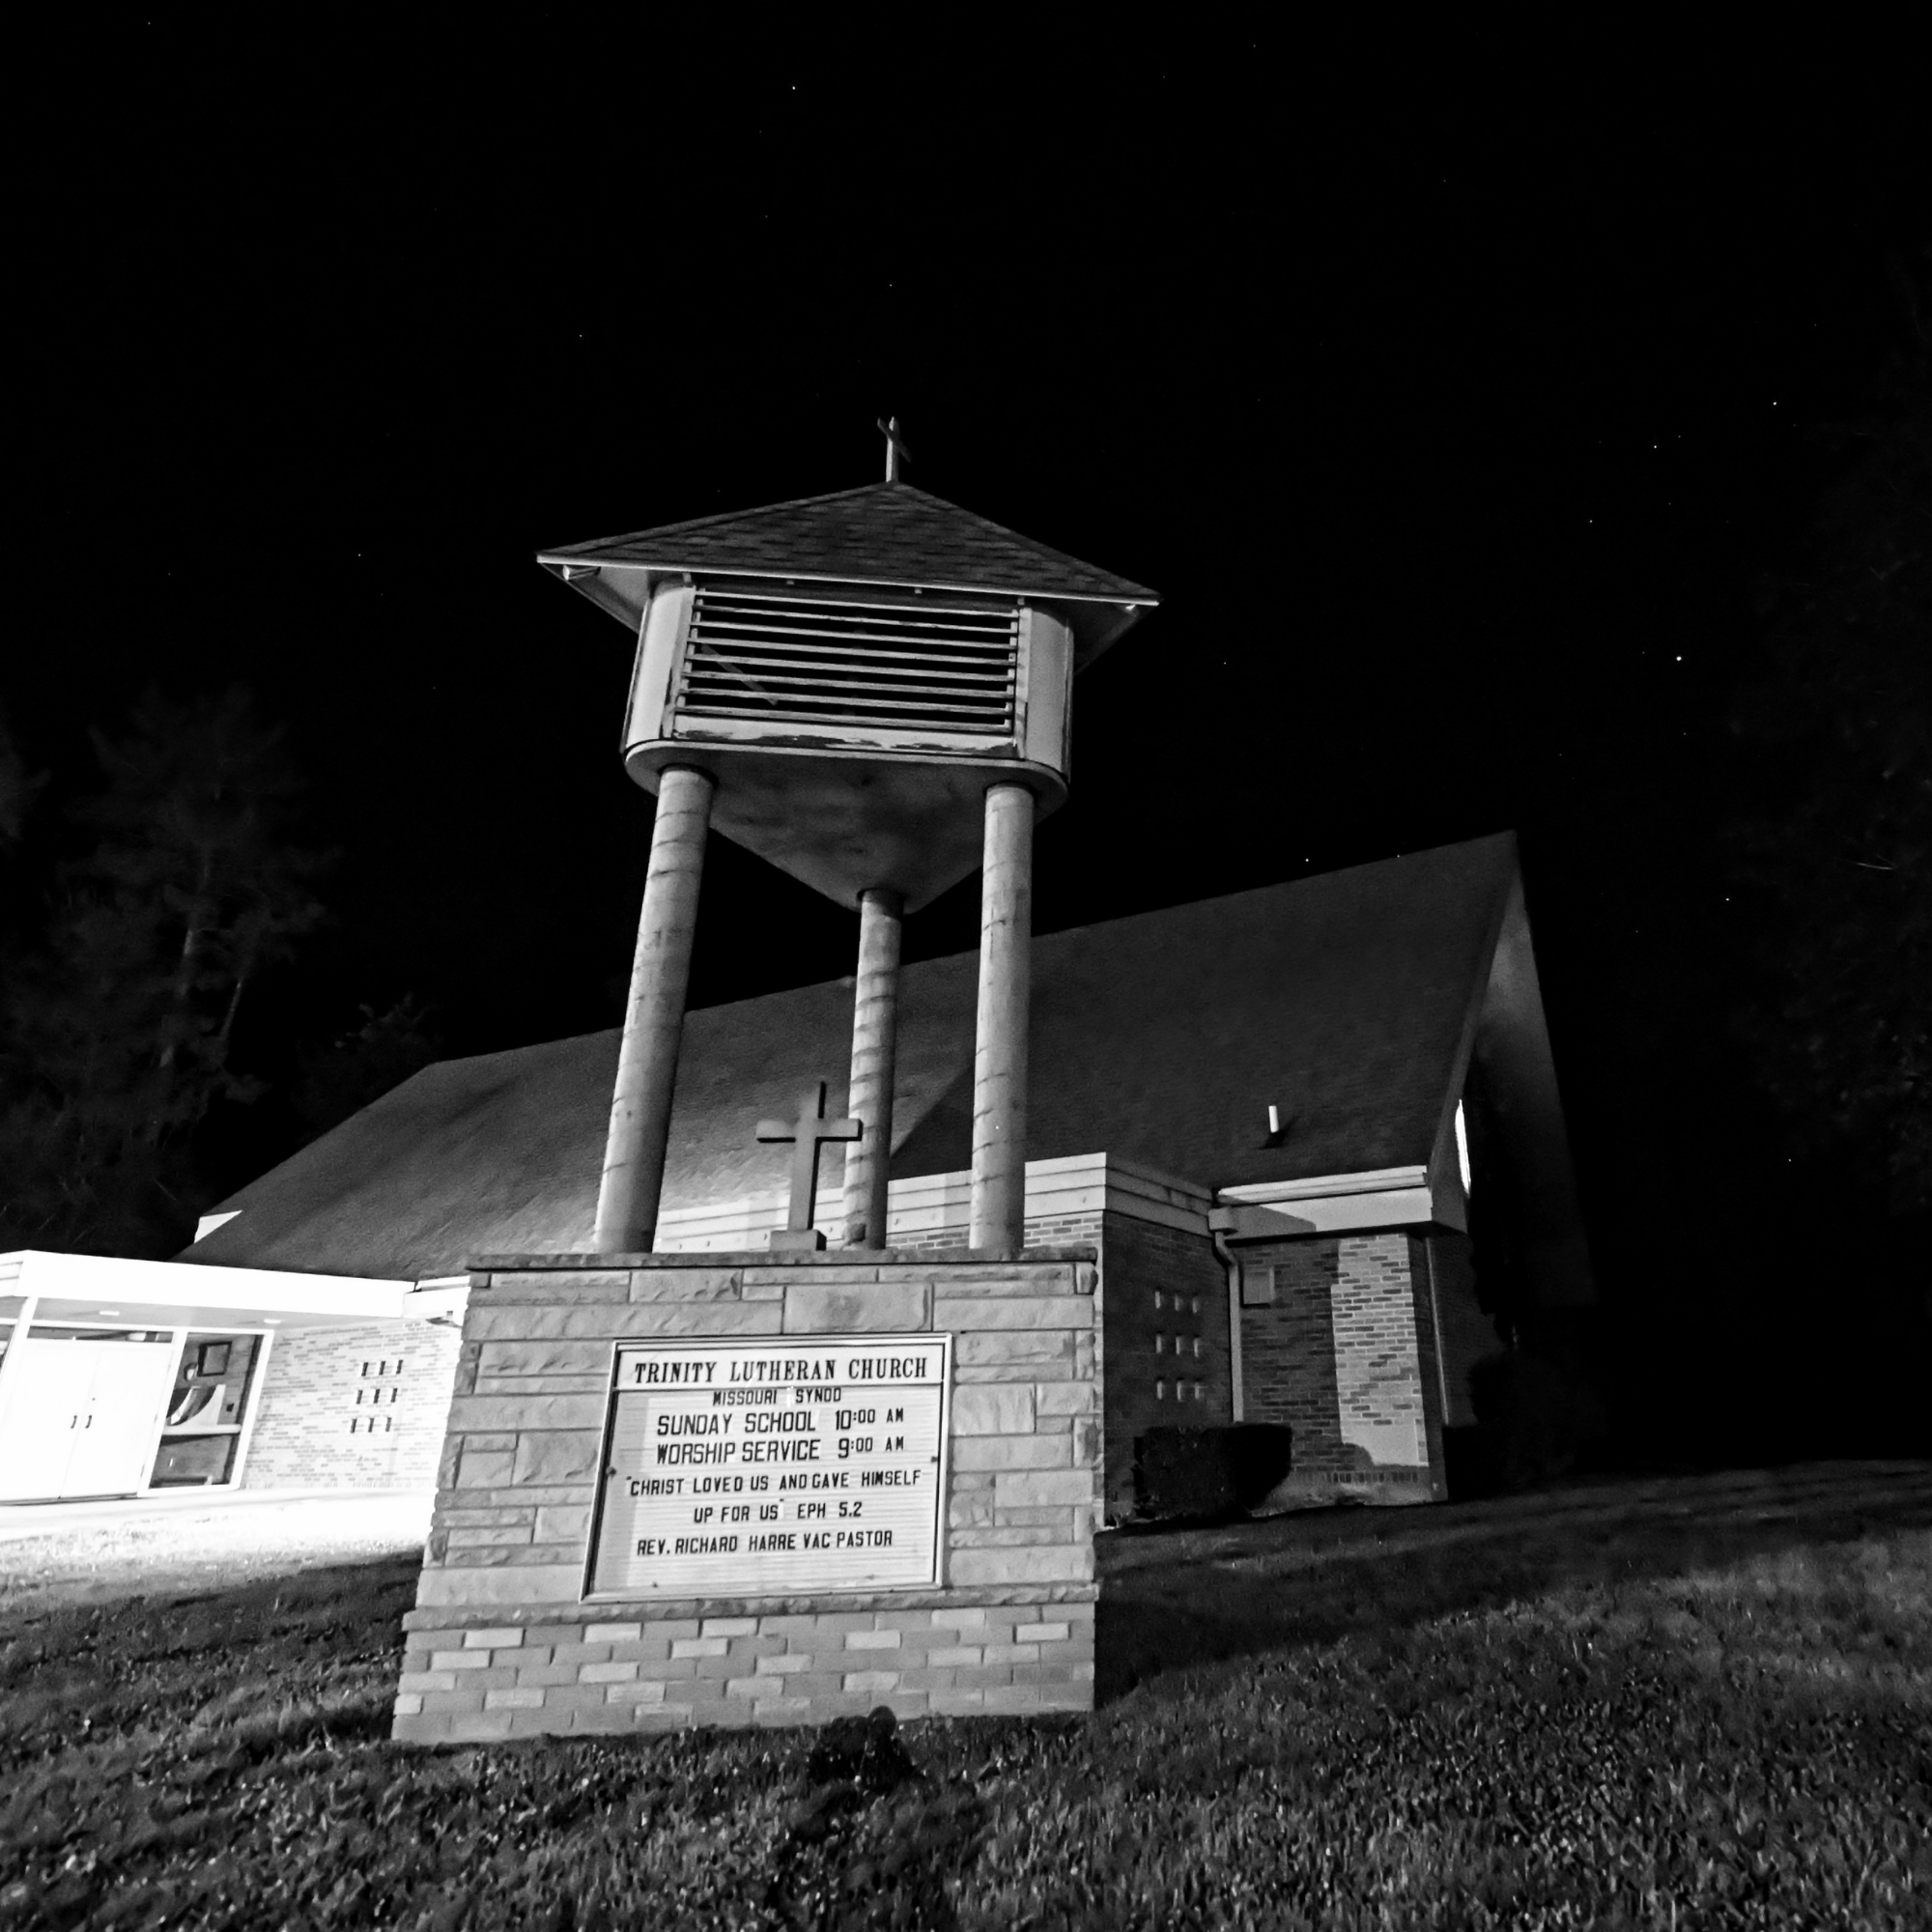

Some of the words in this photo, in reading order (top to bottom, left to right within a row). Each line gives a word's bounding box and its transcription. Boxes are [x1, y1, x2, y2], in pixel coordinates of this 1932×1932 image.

[635, 1362, 717, 1383] TRINITY
[729, 1359, 837, 1382] LUTHERAN
[848, 1357, 927, 1379] CHURCH
[713, 1389, 777, 1406] MISSOURI
[795, 1387, 841, 1404] SYNOD
[657, 1413, 732, 1435] SUNDAY
[745, 1411, 816, 1434] SCHOOL
[836, 1408, 875, 1430] 10:00
[886, 1407, 904, 1423] AM
[657, 1442, 735, 1464] WORSHIP
[742, 1439, 820, 1462] SERVICE
[838, 1437, 873, 1459] 9:00
[886, 1436, 904, 1452] AM
[693, 1476, 743, 1493] LOVED
[751, 1475, 769, 1491] US
[780, 1474, 807, 1491] AND
[812, 1472, 849, 1489] GAVE
[862, 1469, 921, 1488] HIMSELF
[694, 1507, 713, 1523] UP
[721, 1505, 750, 1522] FOR
[797, 1502, 826, 1520] EPH
[838, 1501, 863, 1518] 5.2
[637, 1539, 670, 1556] REV.
[675, 1536, 738, 1554] RICHARD
[749, 1533, 797, 1551] HARRE
[804, 1532, 831, 1549] VAC
[837, 1530, 893, 1548] PASTOR
